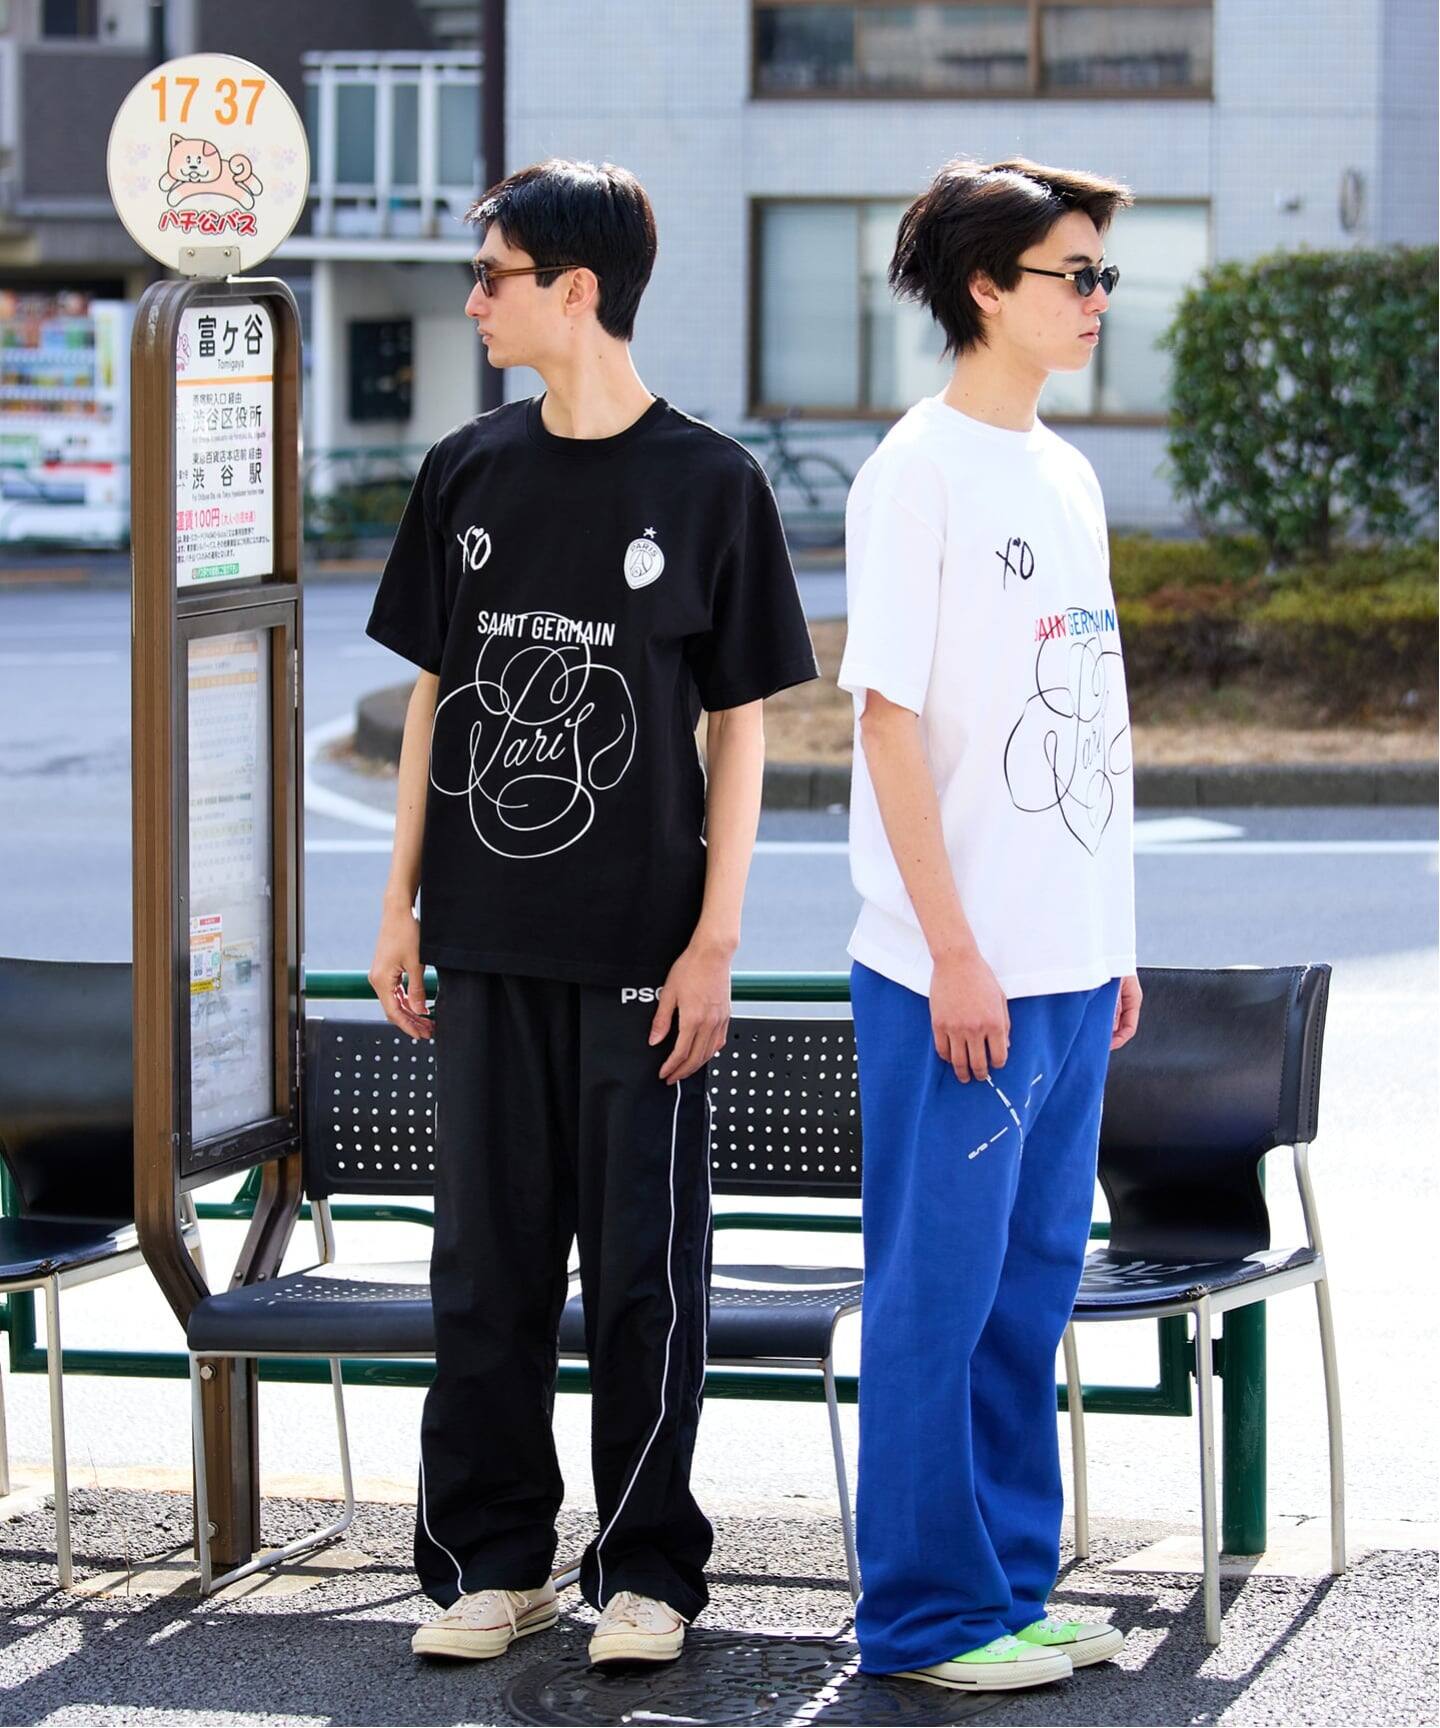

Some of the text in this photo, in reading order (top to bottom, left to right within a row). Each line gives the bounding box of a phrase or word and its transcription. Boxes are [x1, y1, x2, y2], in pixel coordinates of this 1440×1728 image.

[151, 75, 266, 126] 17 37
[158, 208, 257, 236] ハチ公バス
[995, 536, 1035, 592] XO
[477, 610, 616, 647] SAINT GERMAIN
